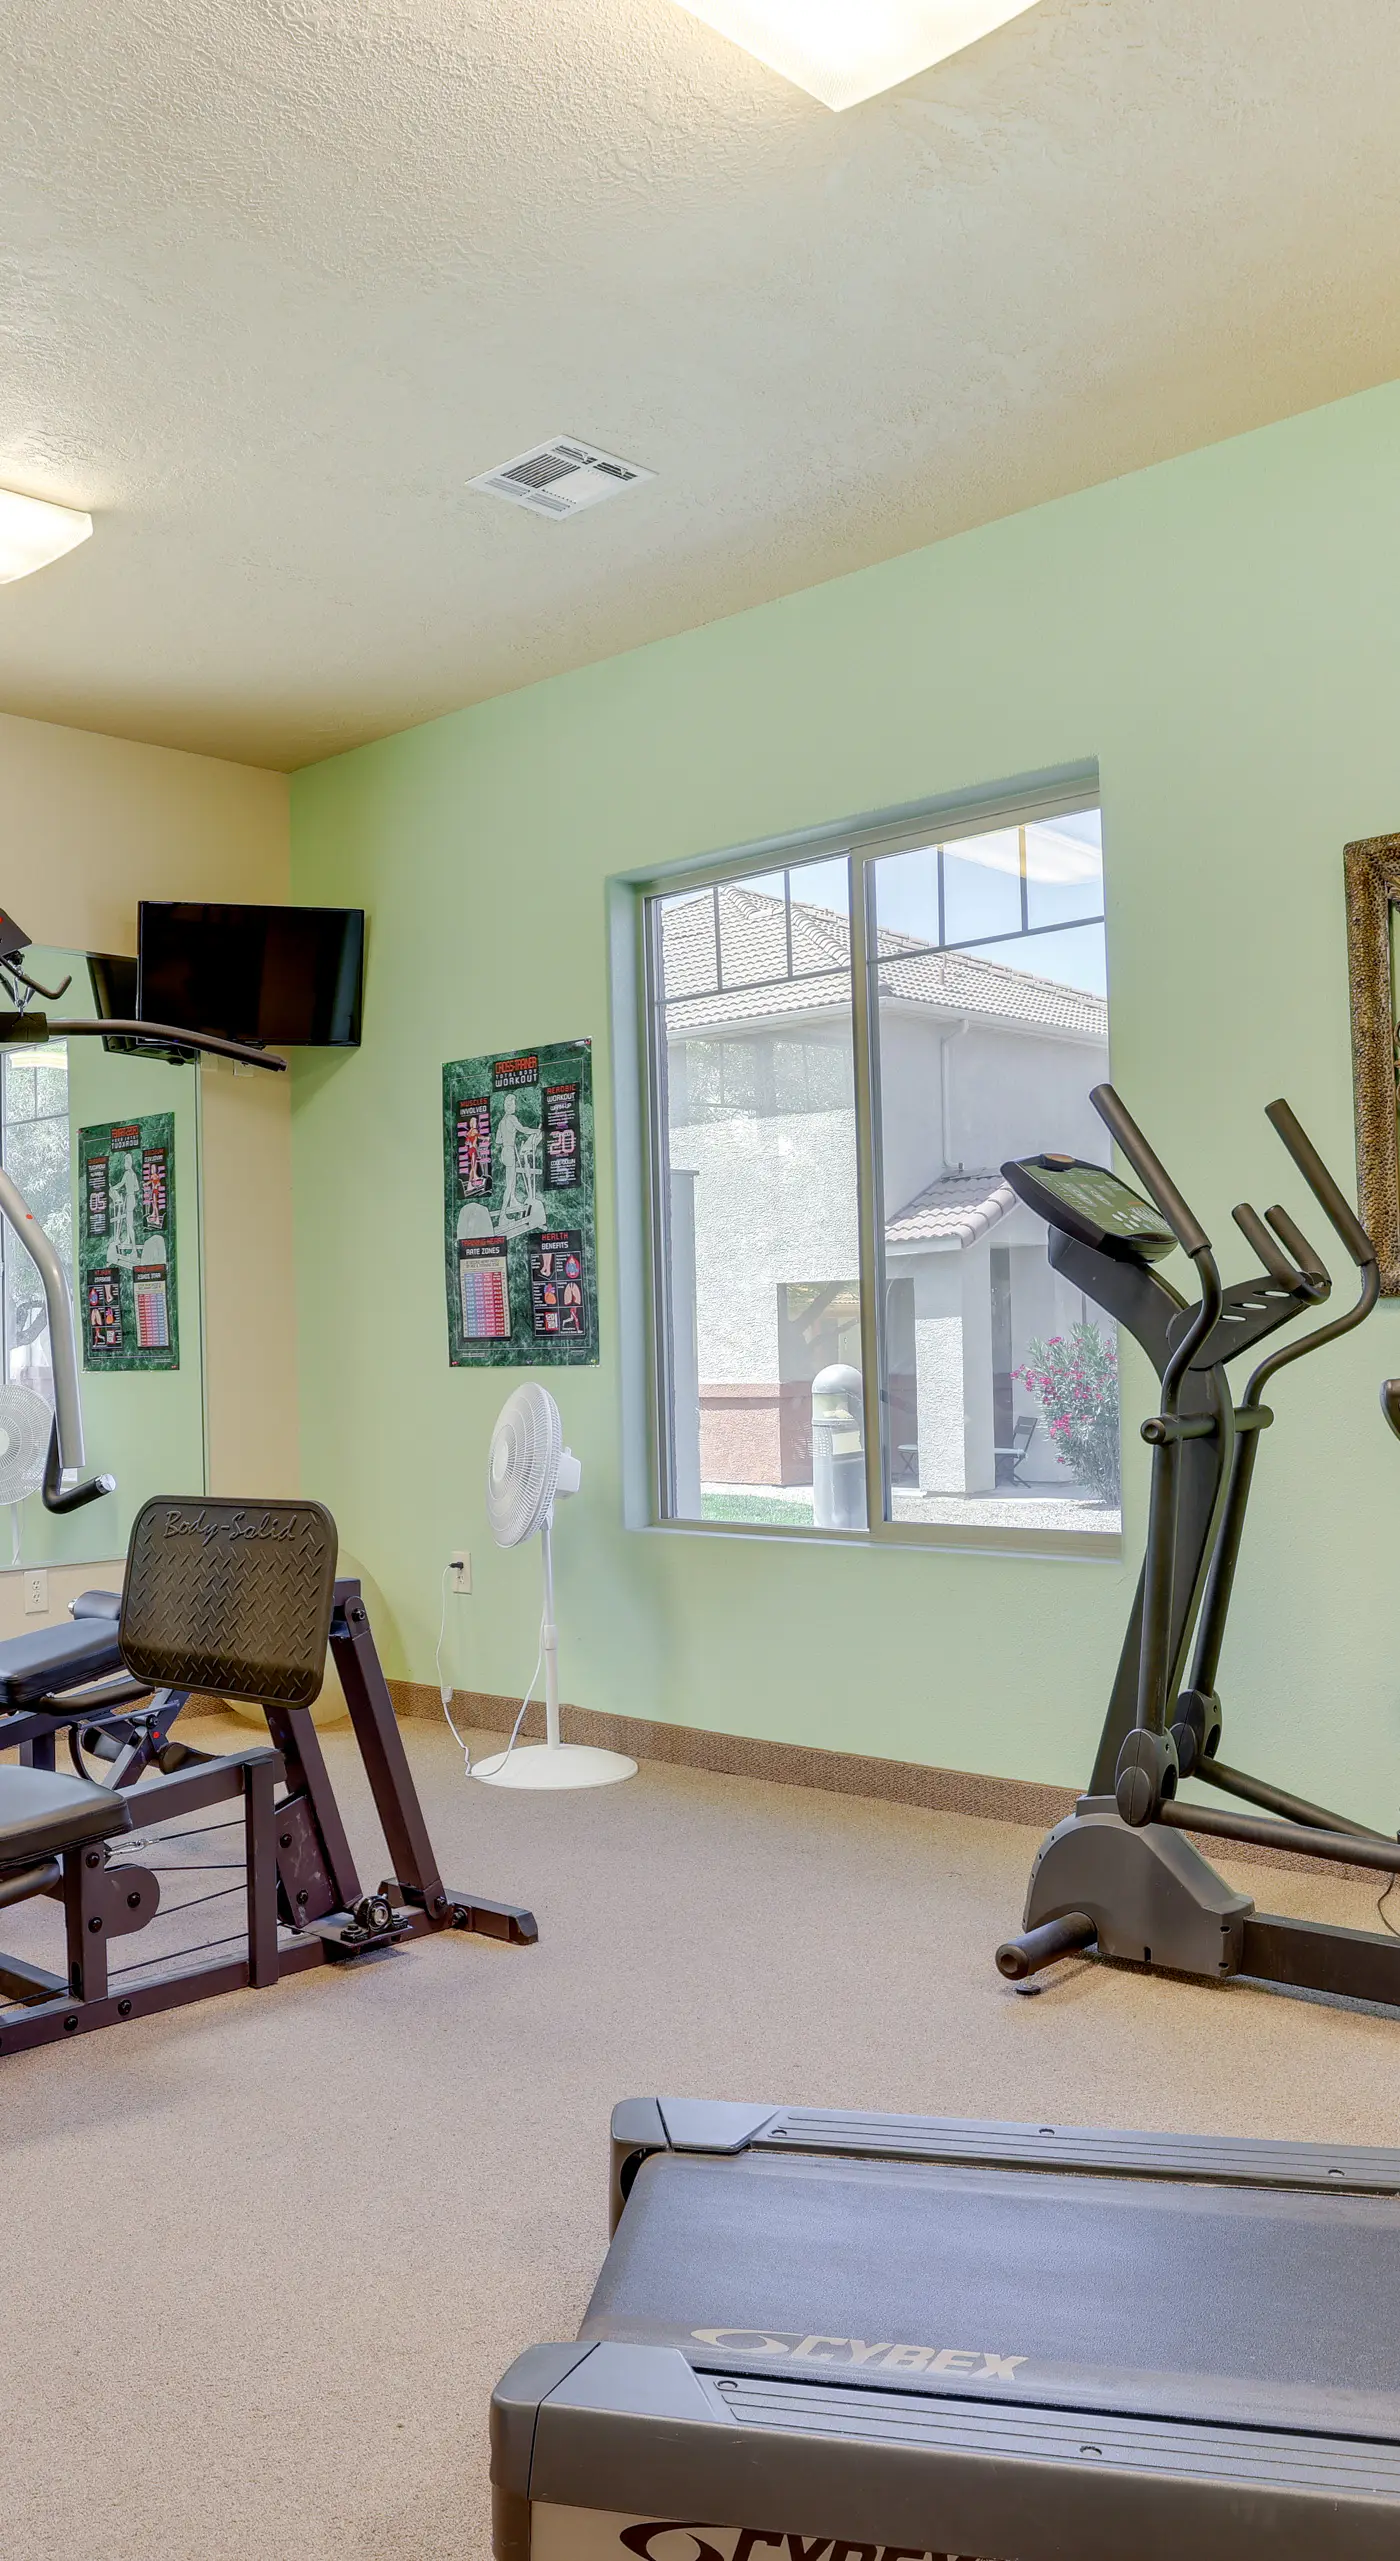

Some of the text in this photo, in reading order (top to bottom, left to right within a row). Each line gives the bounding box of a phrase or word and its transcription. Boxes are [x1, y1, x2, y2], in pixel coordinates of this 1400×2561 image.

[495, 1073, 538, 1087] WORKOUT
[547, 1092, 576, 1103] WORKOUT
[541, 1232, 569, 1241] HEALTH
[465, 1246, 500, 1256] RATE ZONES
[541, 1241, 569, 1250] BENEFITS
[163, 1510, 297, 1547] Body-Solid
[791, 2334, 1029, 2380] CYBEX
